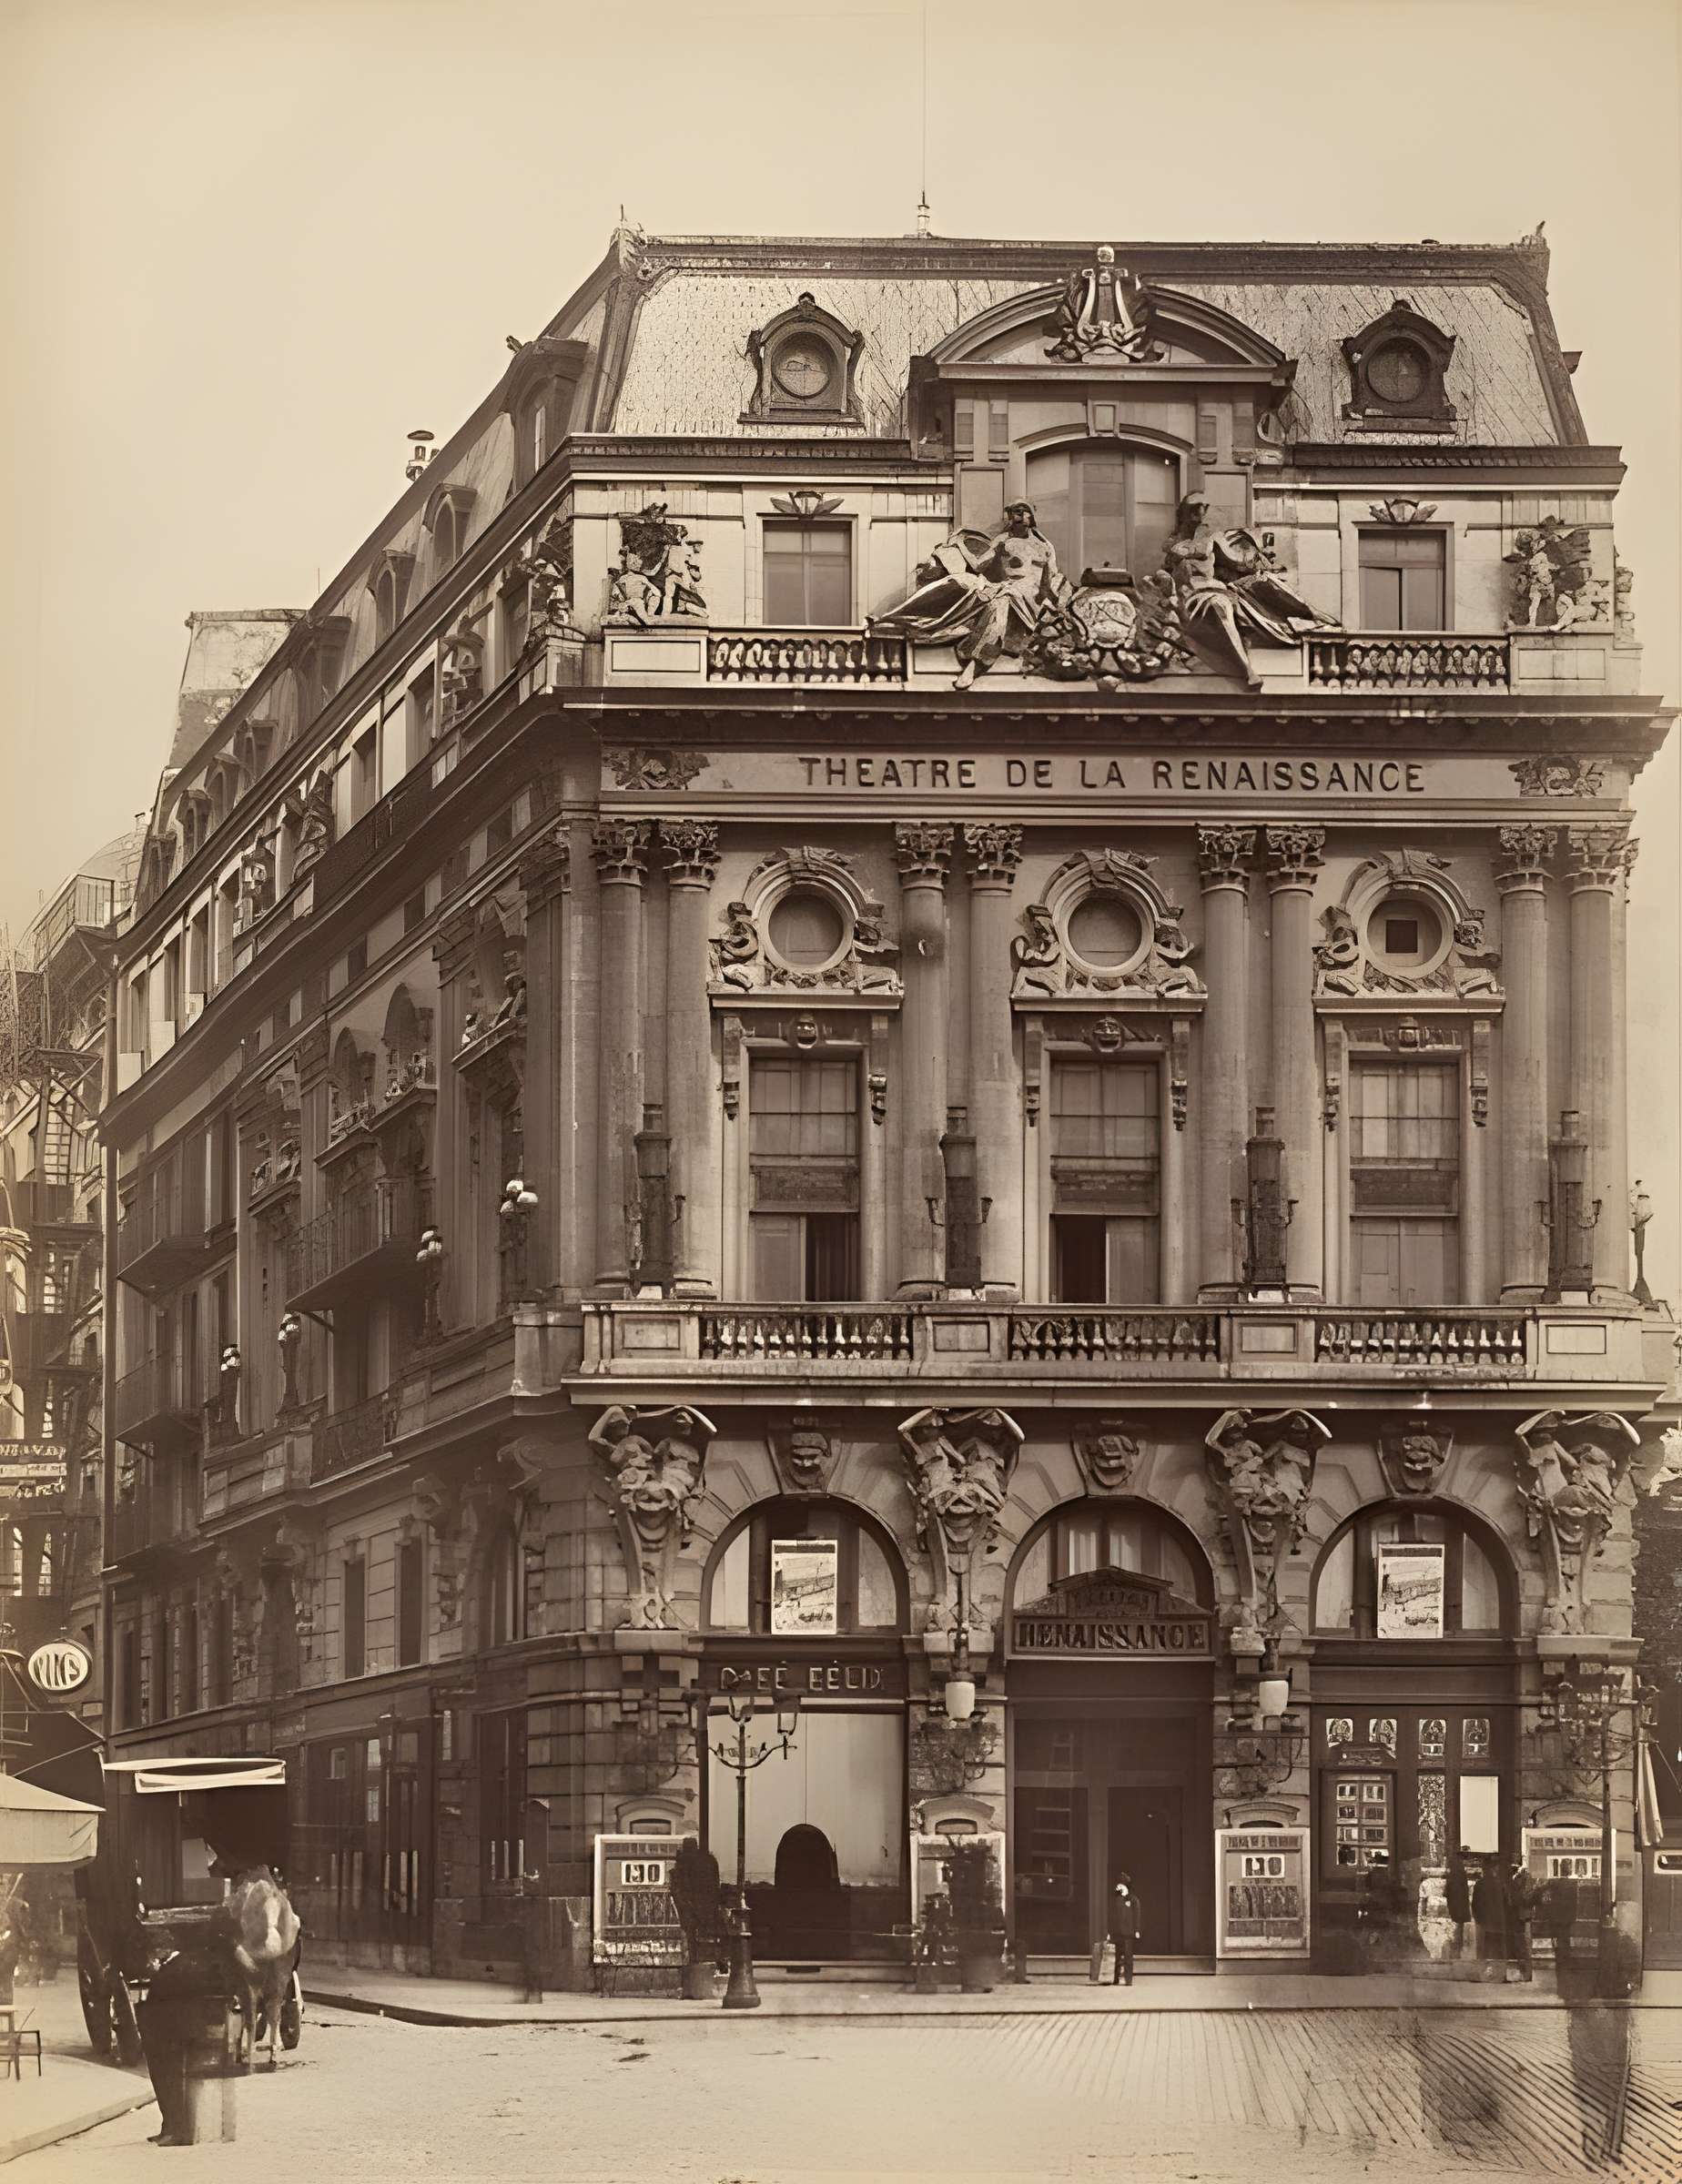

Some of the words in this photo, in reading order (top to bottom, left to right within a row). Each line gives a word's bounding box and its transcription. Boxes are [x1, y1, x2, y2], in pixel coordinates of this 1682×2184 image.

[797, 756, 977, 789] THEATRE
[1006, 759, 1053, 789] DE
[1079, 759, 1127, 789] LA
[1152, 760, 1425, 793] RENAISSANCE
